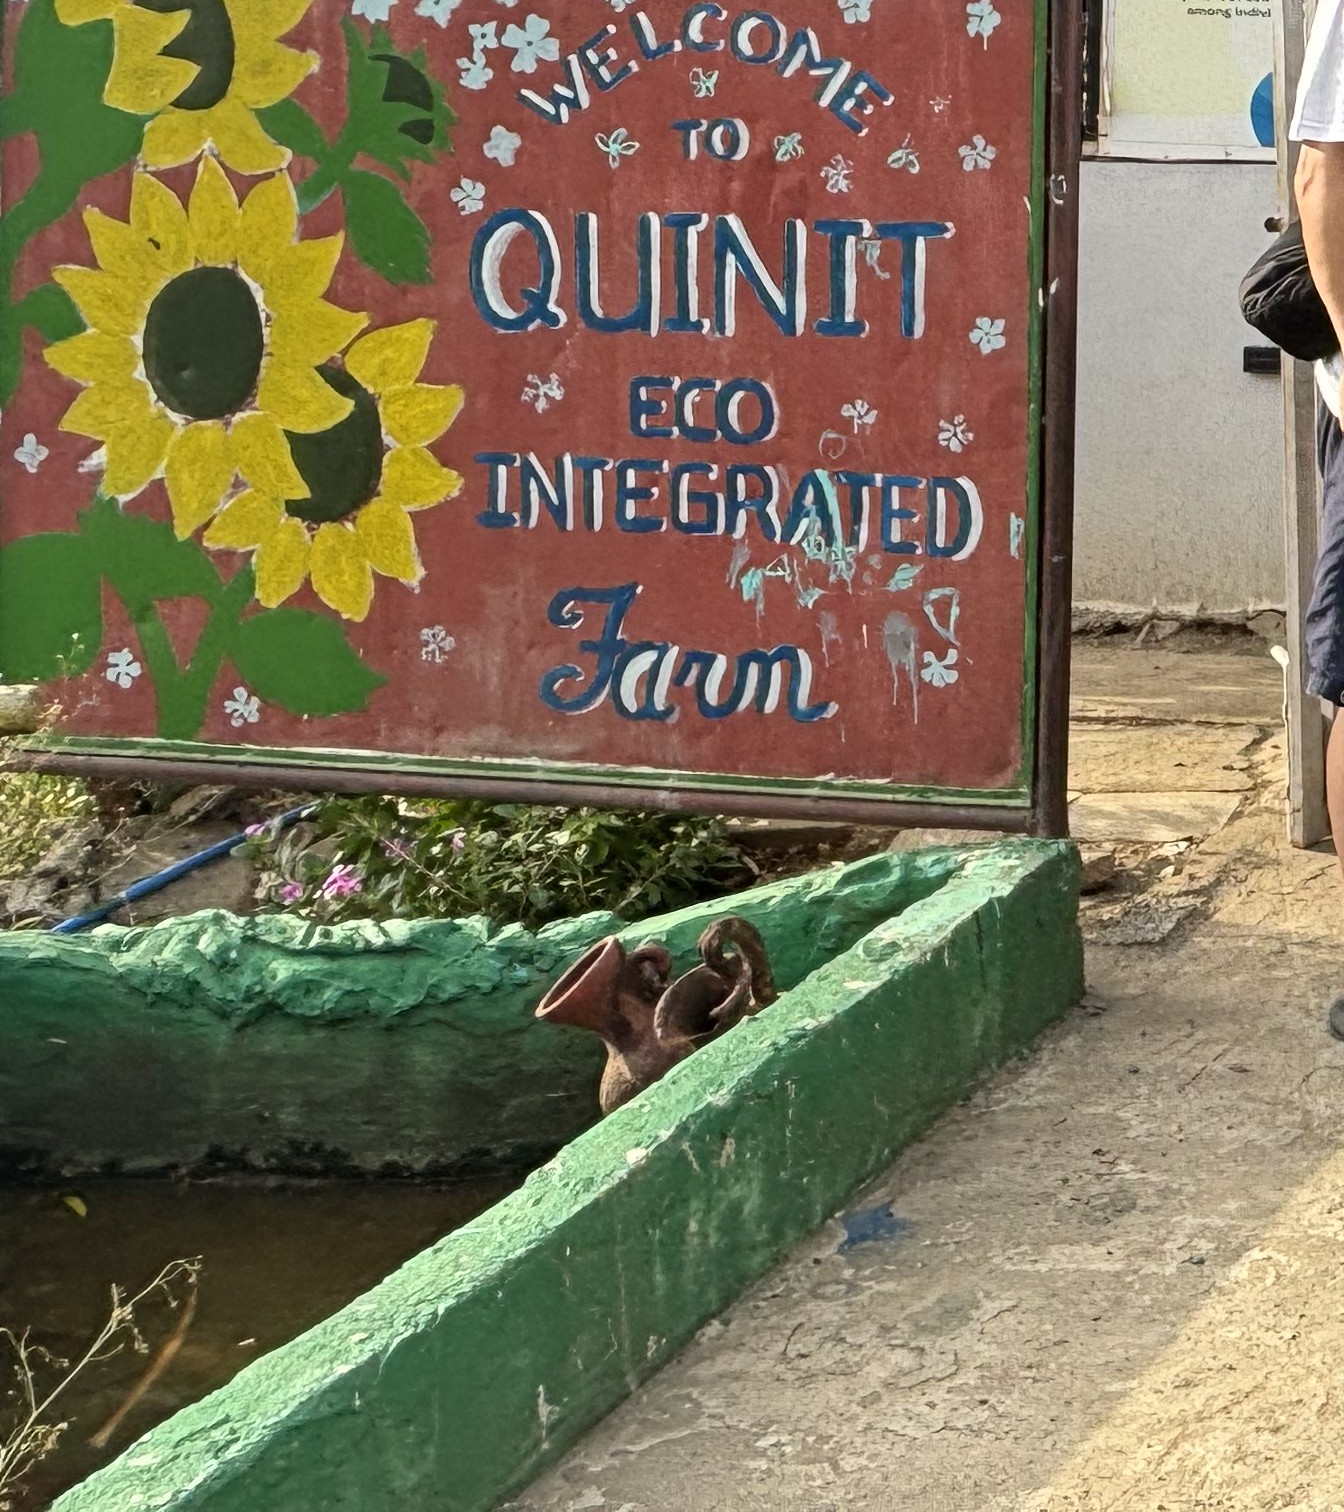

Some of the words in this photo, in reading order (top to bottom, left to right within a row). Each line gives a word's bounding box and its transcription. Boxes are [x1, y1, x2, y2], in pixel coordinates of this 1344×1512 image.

[516, 1, 895, 137] WELCOME
[672, 117, 750, 161] TO
[469, 207, 956, 339] QUINIT
[629, 375, 781, 445] ECO
[473, 451, 984, 561] INTEGRATED
[539, 581, 838, 724] Farm
